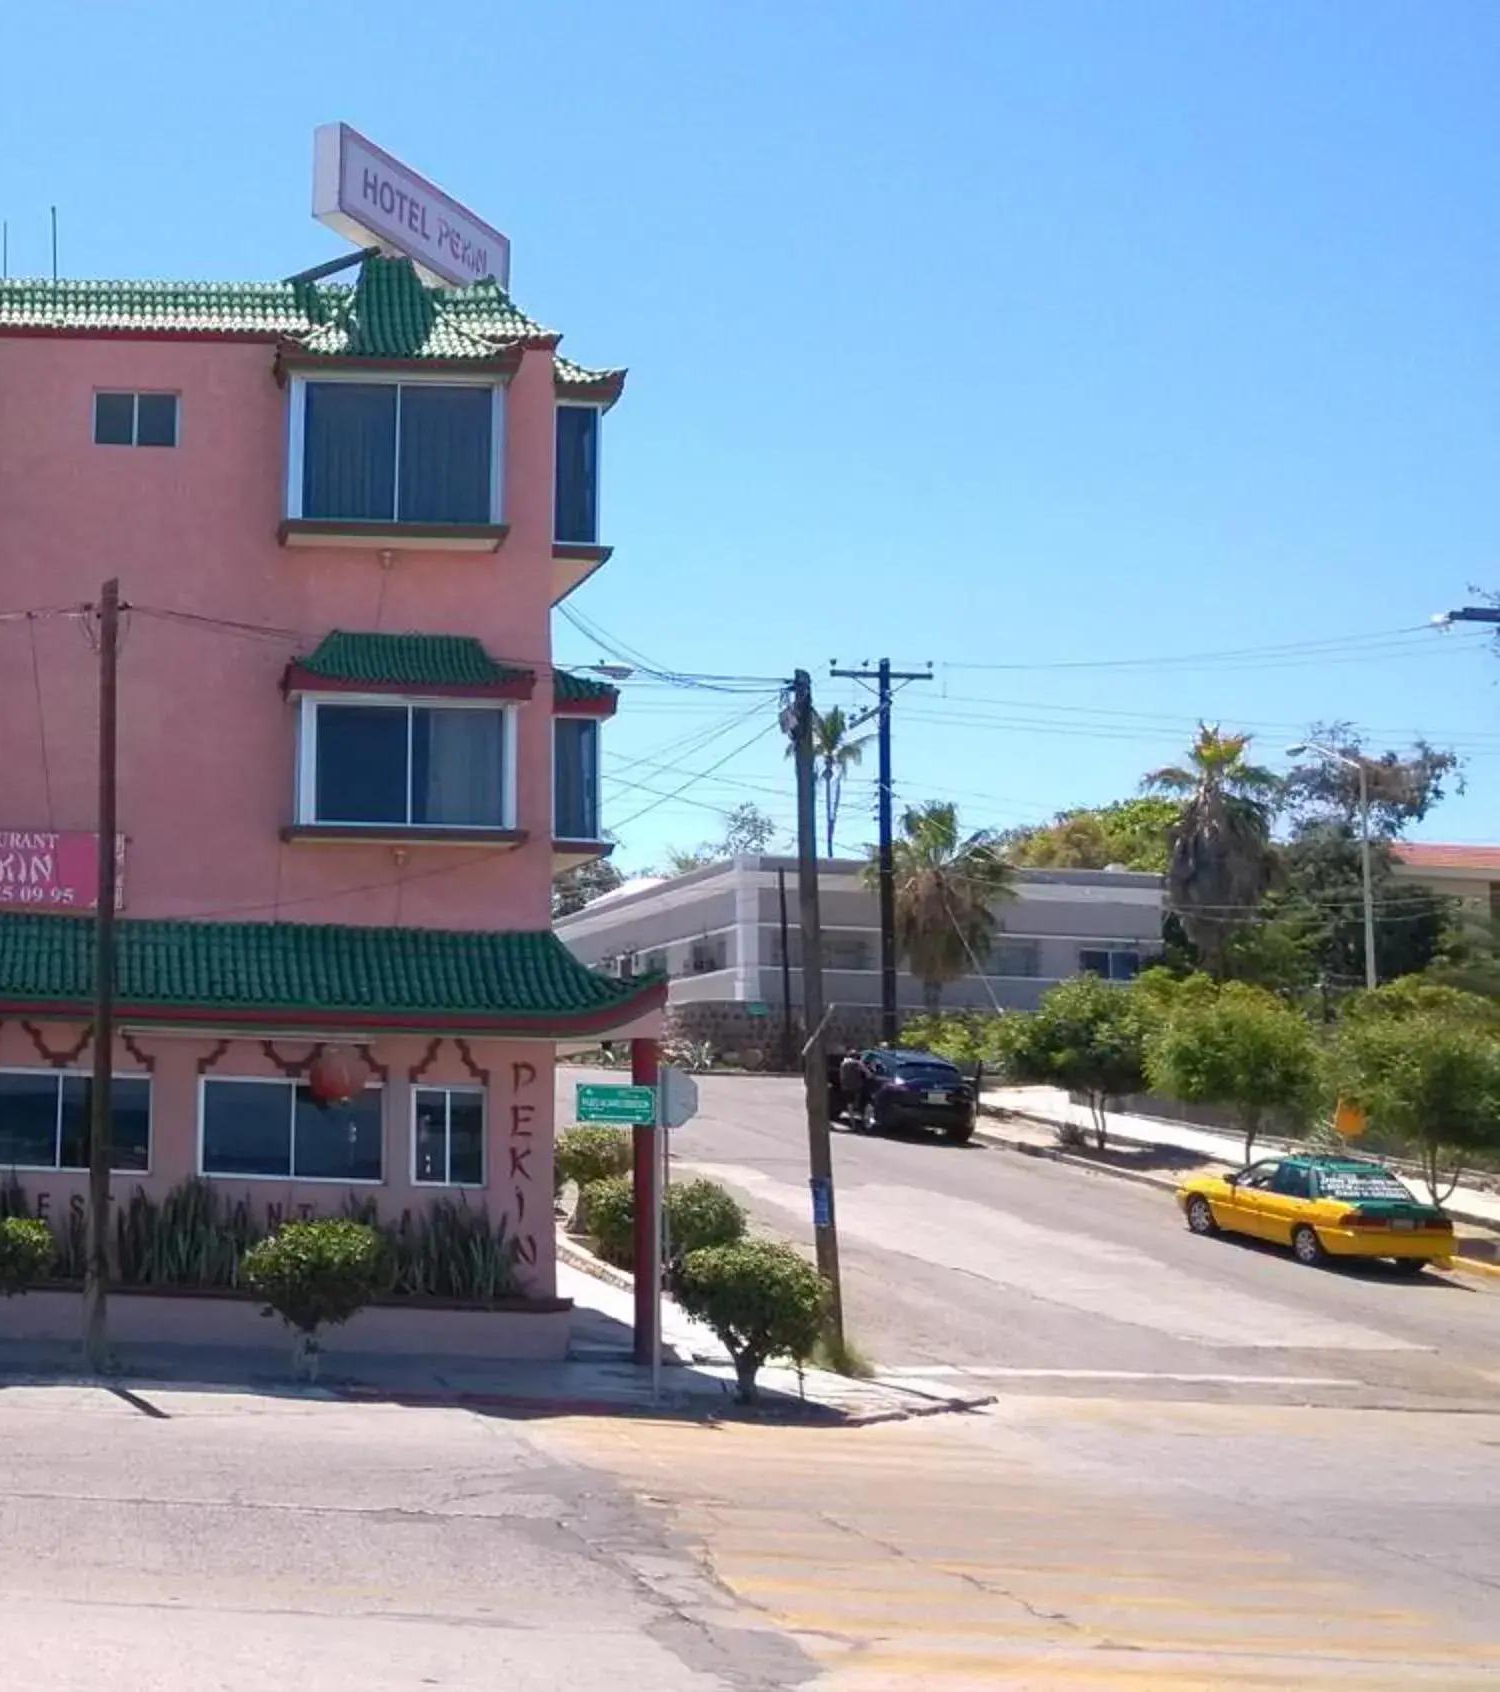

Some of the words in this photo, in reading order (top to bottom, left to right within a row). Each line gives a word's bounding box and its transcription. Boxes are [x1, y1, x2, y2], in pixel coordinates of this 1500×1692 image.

[363, 168, 431, 241] HOTEL
[437, 214, 488, 275] PEKIN
[20, 885, 43, 902] 09
[509, 1061, 538, 1267] PEKIN
